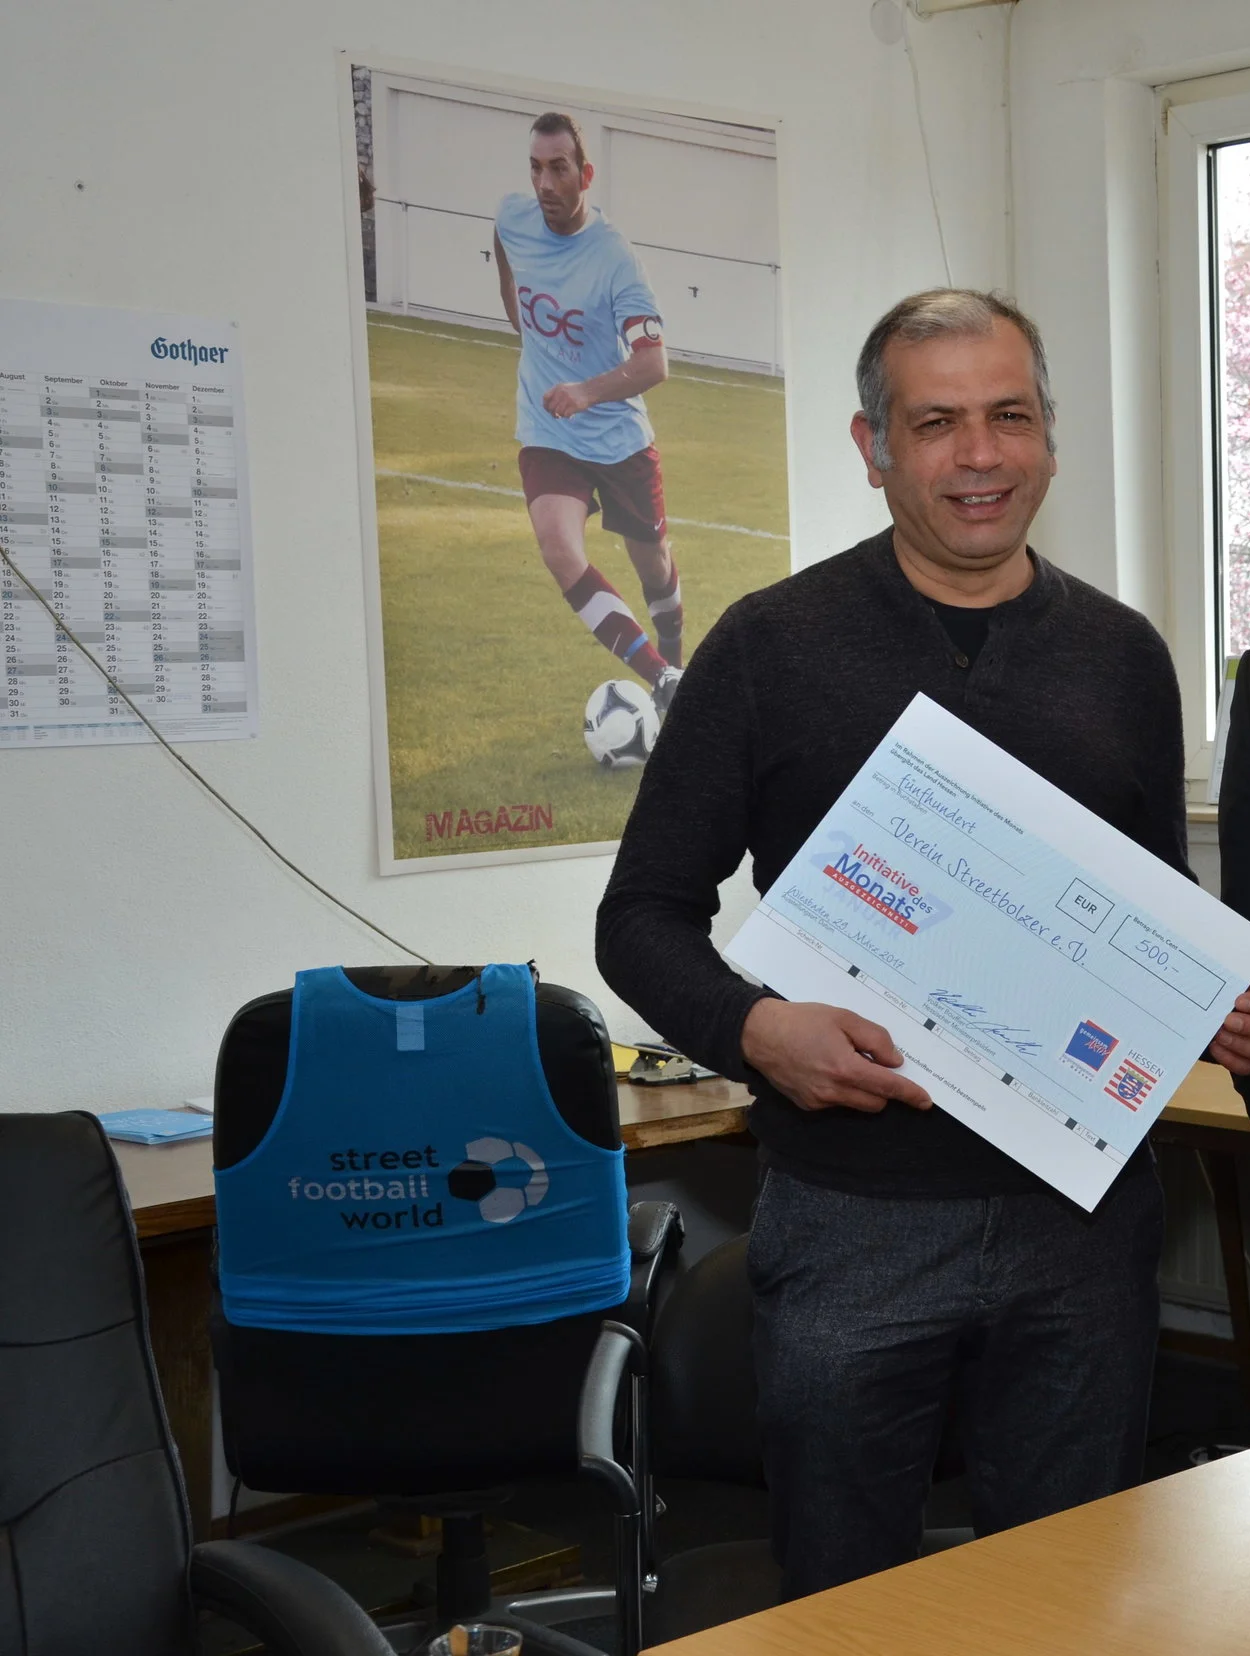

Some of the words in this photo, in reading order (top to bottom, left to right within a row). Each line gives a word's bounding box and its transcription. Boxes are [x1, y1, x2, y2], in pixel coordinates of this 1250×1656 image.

[150, 336, 229, 366] Gothaer
[0, 372, 26, 381] August
[44, 375, 83, 385] September
[100, 379, 128, 388] Oktober
[146, 382, 180, 390] November
[192, 386, 224, 394] Dezember
[145, 402, 151, 411] 2
[195, 447, 200, 455] 6
[195, 457, 200, 465] 7
[149, 466, 154, 474] 8
[196, 468, 201, 476] 8
[196, 478, 202, 486] 9
[147, 508, 157, 516] 12
[149, 550, 159, 558] 16
[196, 571, 206, 579] 18
[150, 591, 160, 599] 20
[198, 602, 207, 610] 21
[151, 612, 161, 620] 22
[198, 612, 208, 620] 22
[153, 633, 162, 641] 24
[199, 643, 209, 651] 25
[153, 654, 164, 662] 26
[200, 653, 210, 661] 26
[156, 695, 166, 703] 30
[202, 694, 212, 702] 30
[203, 704, 211, 712] 31
[890, 748, 914, 768] übergibt
[924, 772, 940, 784] Land
[936, 781, 957, 798] Hessen
[903, 747, 925, 765] Rahmen
[924, 762, 935, 772] der
[934, 769, 971, 799] Auszeichnung
[971, 794, 994, 814] Initiative
[993, 810, 1004, 821] des
[1004, 817, 1024, 835] Monats
[898, 773, 977, 834] fünfhundert
[852, 843, 920, 897] Initiative
[912, 896, 933, 914] des
[890, 817, 945, 865] Verein
[947, 858, 1050, 936] Streetbolzer
[834, 852, 915, 920] Monats
[1074, 894, 1098, 915] EUR
[1133, 916, 1152, 932] Betrag:
[1151, 930, 1166, 943] Euro,
[1166, 940, 1179, 951] Cent
[1127, 1049, 1165, 1078] HESSEN
[904, 1050, 933, 1075] beschriften
[932, 1071, 944, 1082] und
[944, 1079, 957, 1092] nicht
[956, 1088, 987, 1112] bestempeln
[329, 1145, 439, 1171] street
[288, 1175, 430, 1201] football
[339, 1202, 444, 1230] world
